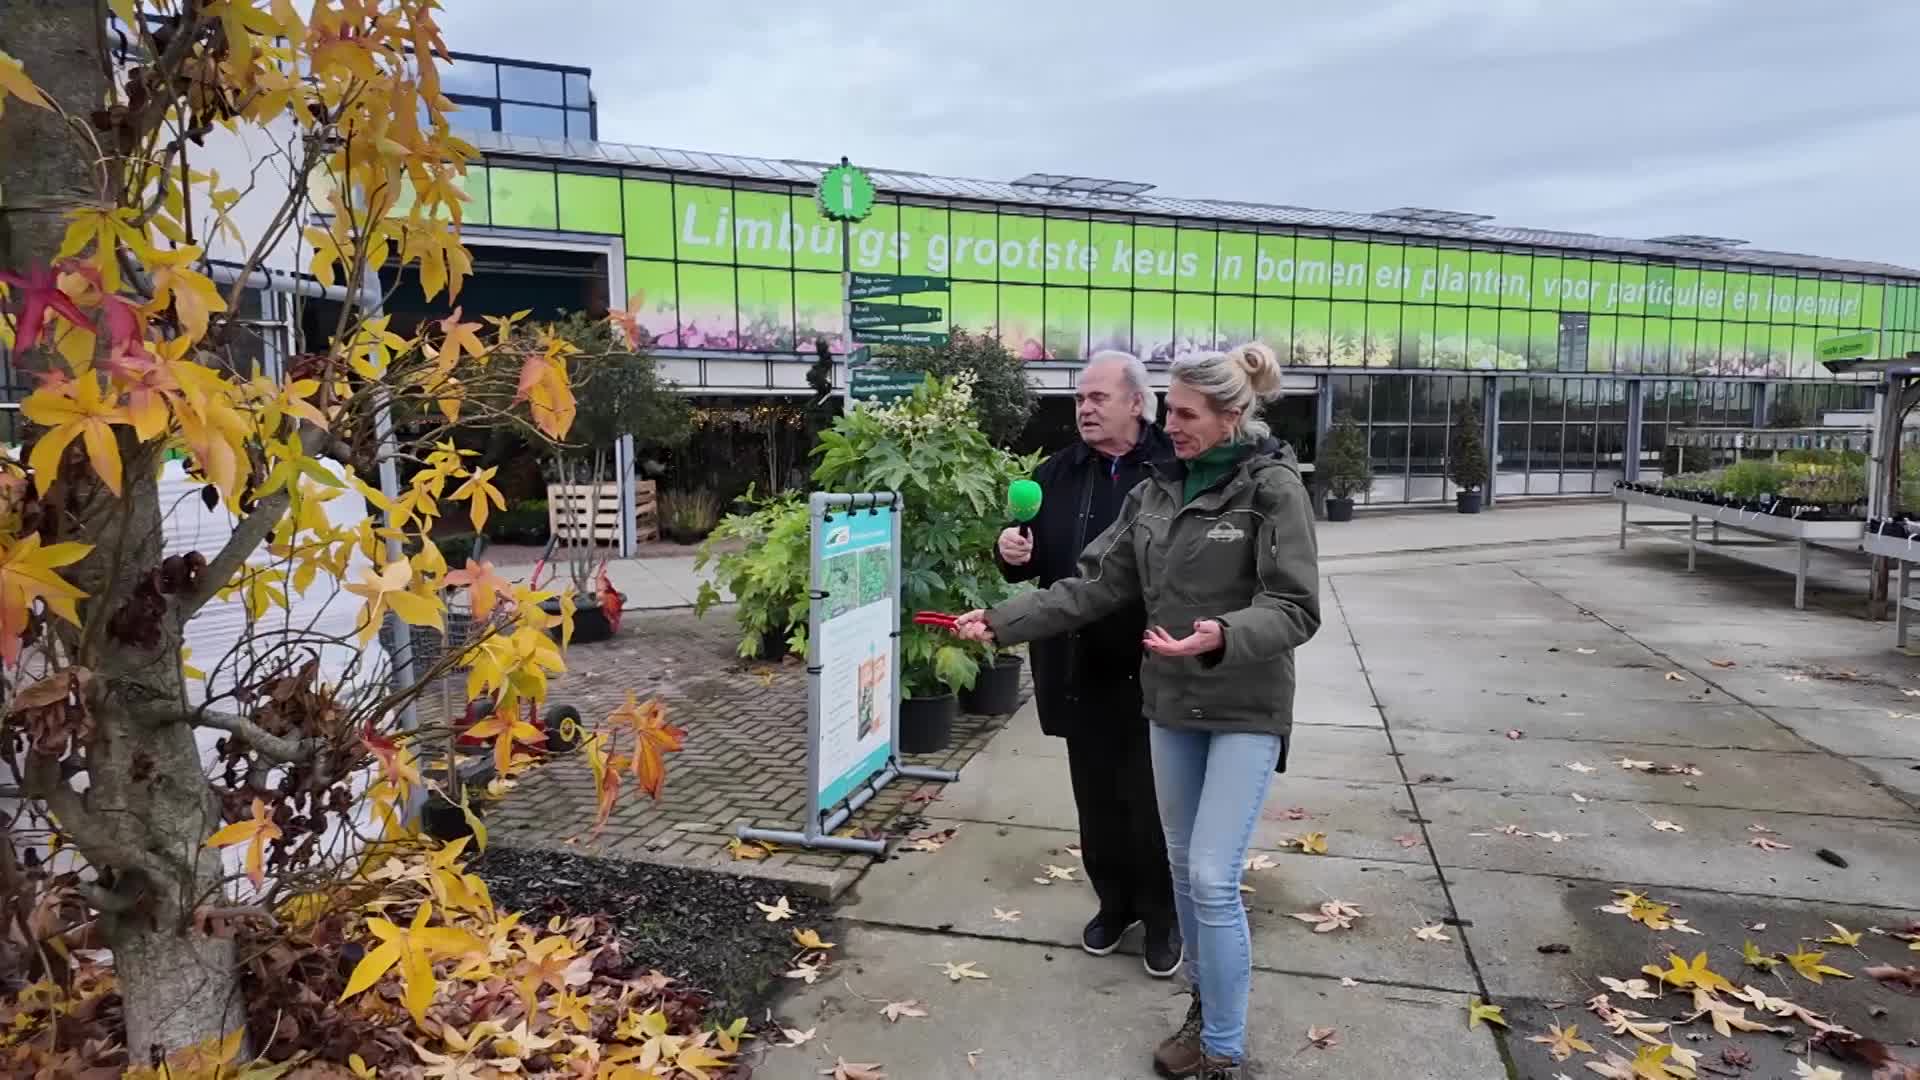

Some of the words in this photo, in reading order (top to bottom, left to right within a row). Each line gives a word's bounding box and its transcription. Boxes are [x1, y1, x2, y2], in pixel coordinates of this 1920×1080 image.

[682, 202, 911, 268] Limburgs
[927, 233, 1098, 273] grootste
[1111, 239, 1198, 277] keus
[1211, 244, 1243, 281] in
[1256, 250, 1366, 287] bomen
[1376, 263, 1411, 289] en
[1420, 261, 1532, 302] planten,
[1543, 276, 1598, 303] voor
[1606, 279, 1727, 309] particulier
[1765, 286, 1860, 318] hovenier!
